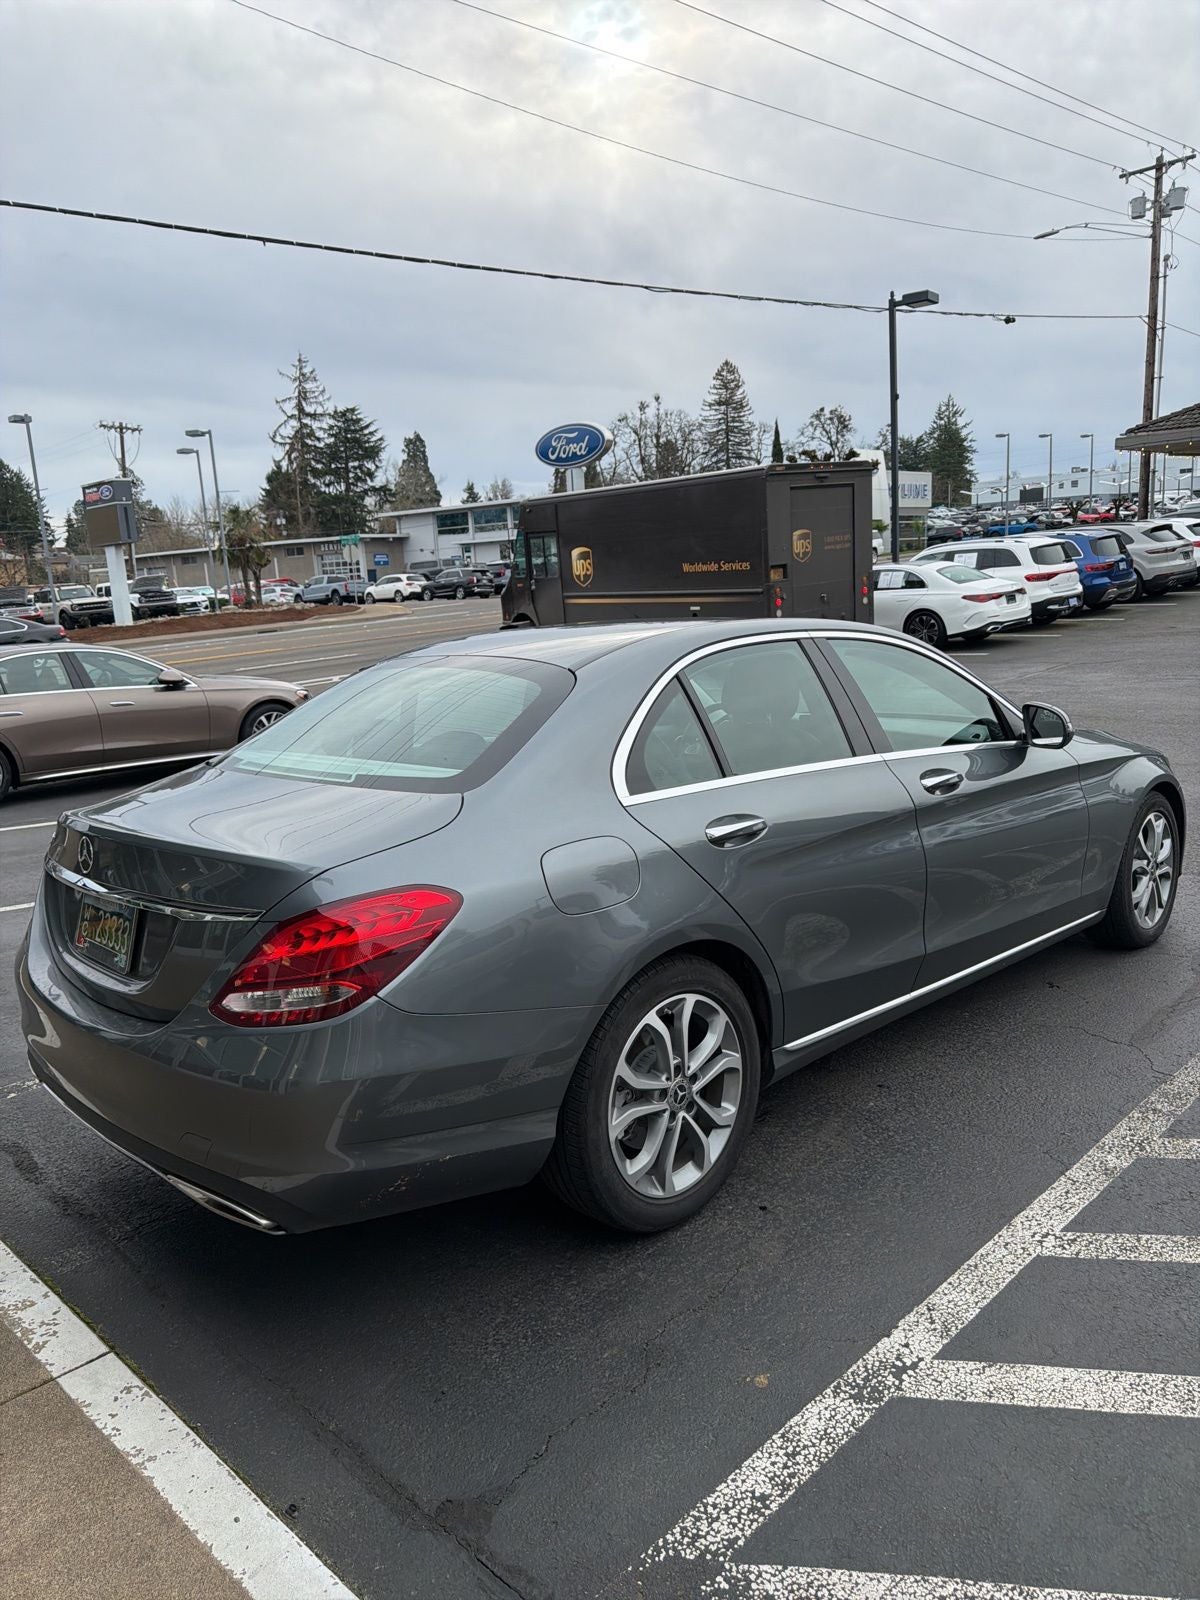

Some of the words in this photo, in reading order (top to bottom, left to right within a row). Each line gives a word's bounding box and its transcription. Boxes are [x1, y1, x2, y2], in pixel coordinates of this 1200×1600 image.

[548, 431, 589, 460] Ford
[793, 539, 811, 558] ups
[574, 559, 592, 581] ups
[682, 562, 719, 573] Worldwide
[720, 560, 751, 571] Services
